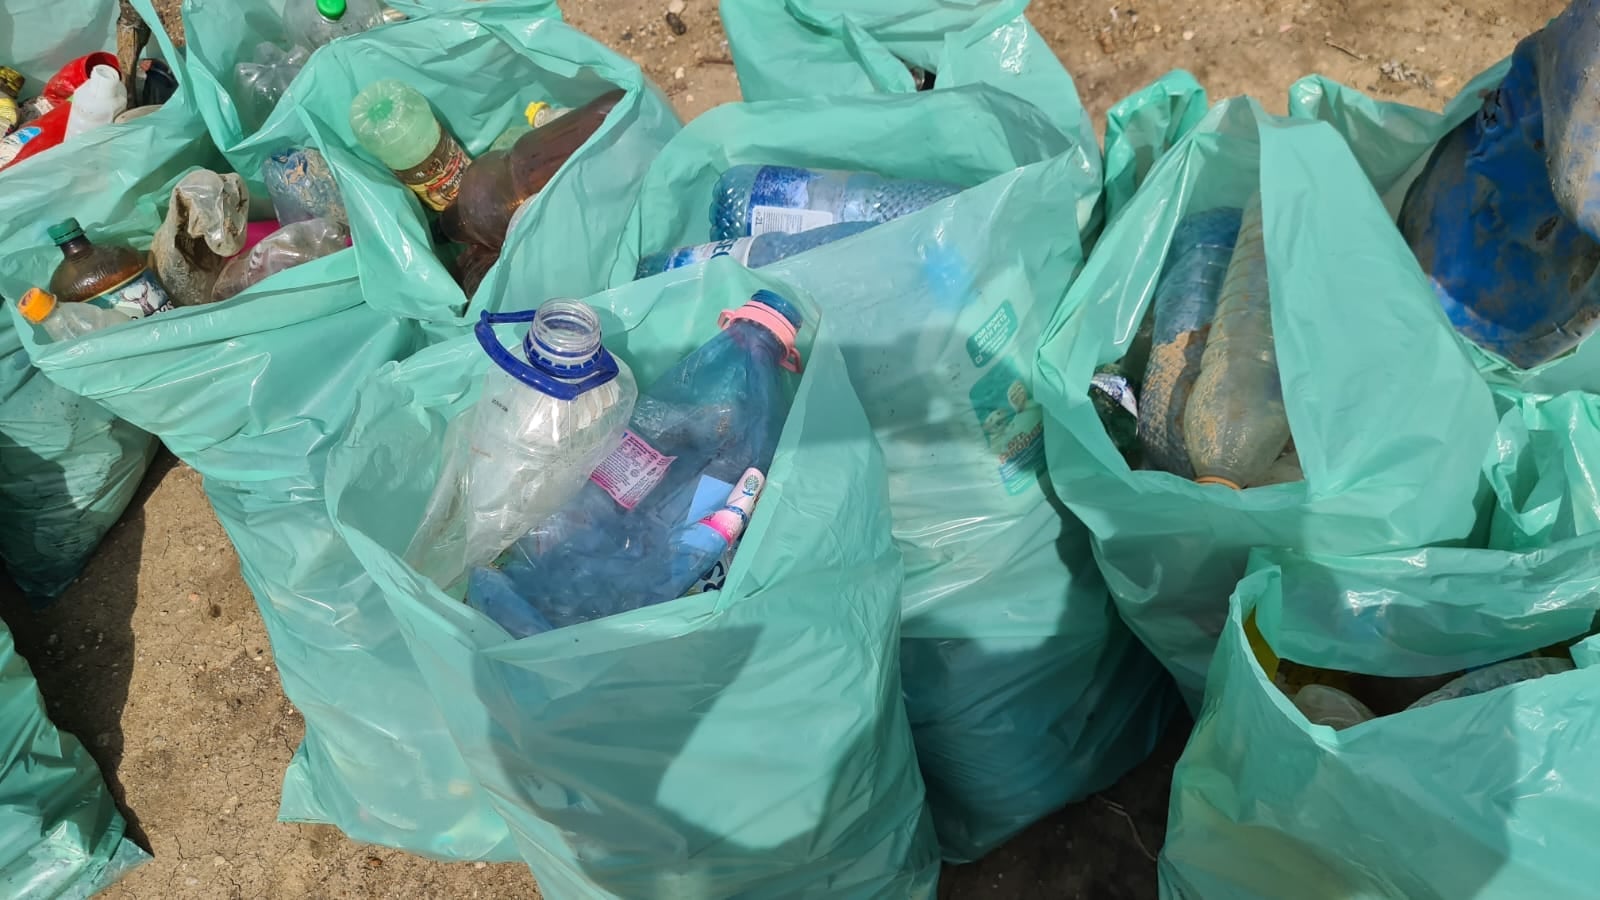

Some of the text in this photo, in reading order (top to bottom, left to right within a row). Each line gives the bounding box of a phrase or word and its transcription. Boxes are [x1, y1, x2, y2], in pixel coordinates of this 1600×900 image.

[974, 327, 987, 342] FOR
[986, 307, 1005, 330] HOMES
[977, 328, 993, 348] WITH
[992, 313, 1008, 331] PETS
